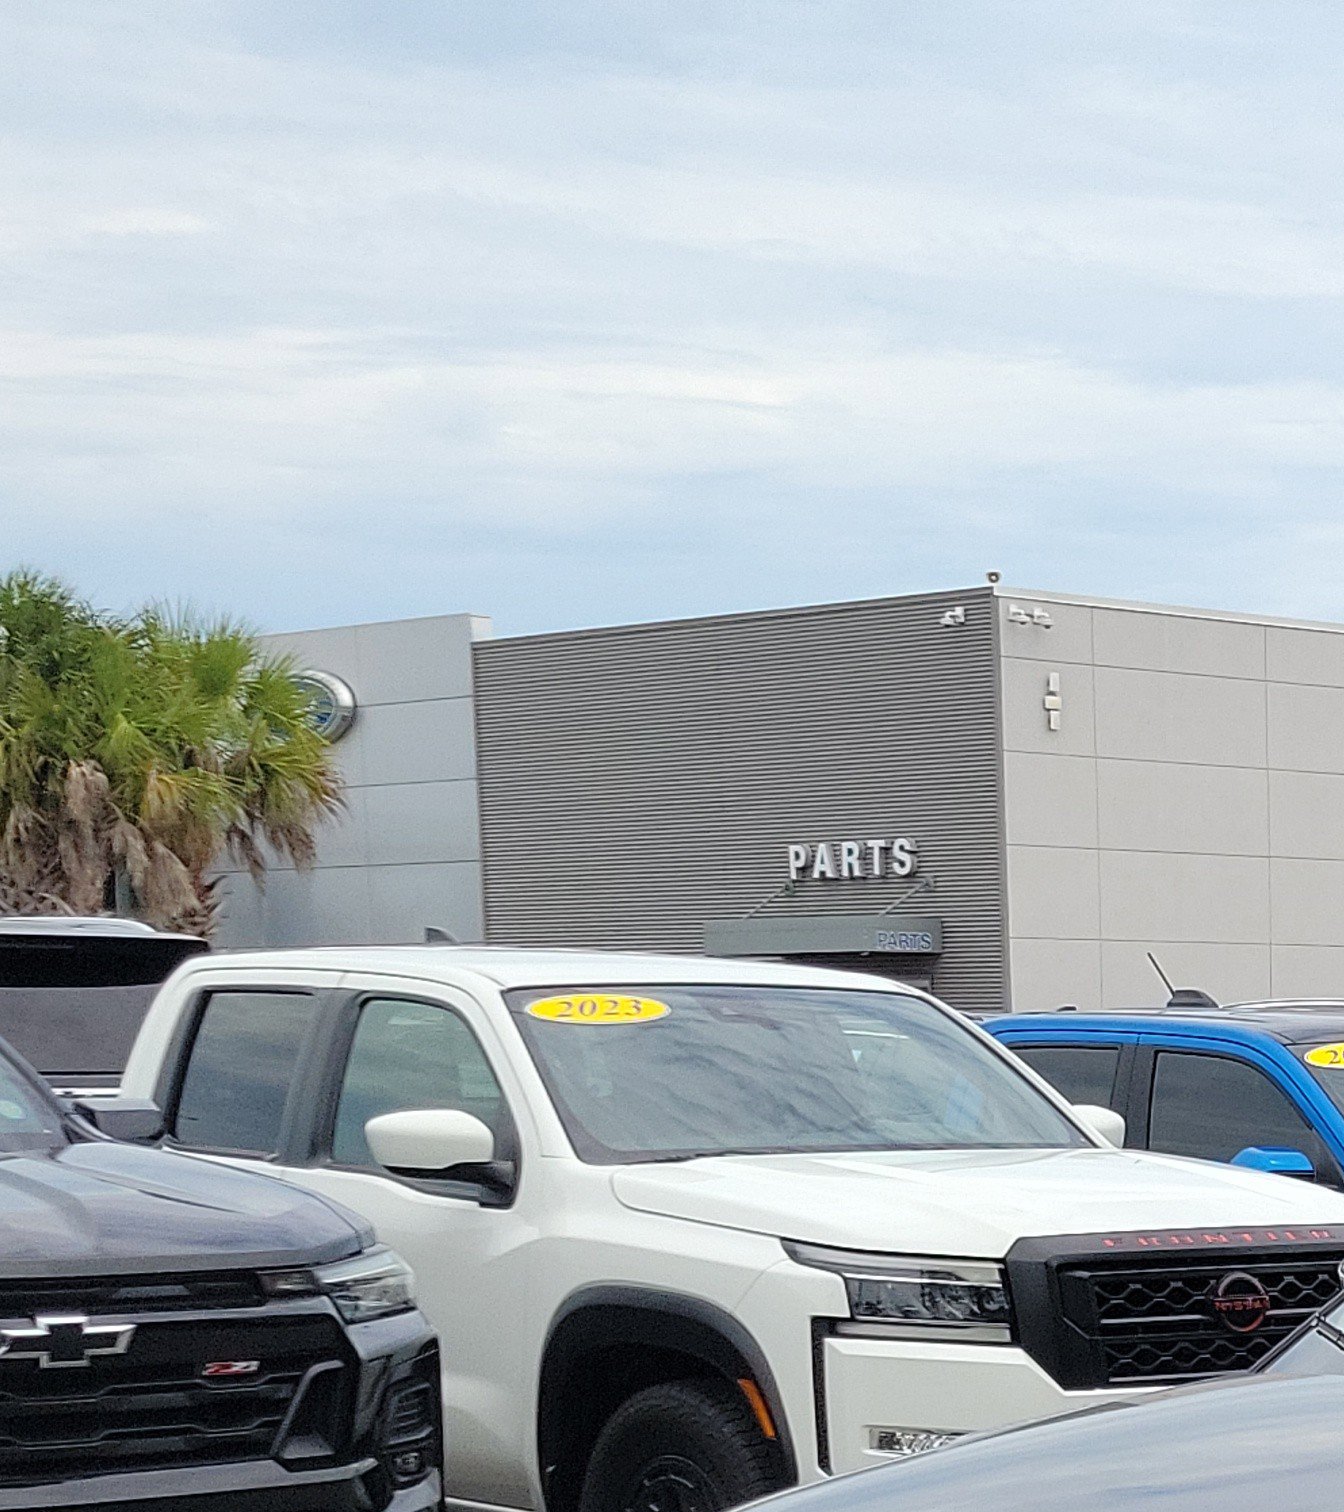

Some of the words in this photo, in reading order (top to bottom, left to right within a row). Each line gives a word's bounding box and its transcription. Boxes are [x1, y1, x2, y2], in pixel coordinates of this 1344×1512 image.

[788, 837, 918, 880] PARTS
[877, 932, 933, 951] PARTS
[555, 998, 643, 1018] 2023
[1101, 1228, 1337, 1248] FRONTIER
[1214, 1298, 1270, 1312] NISSAN
